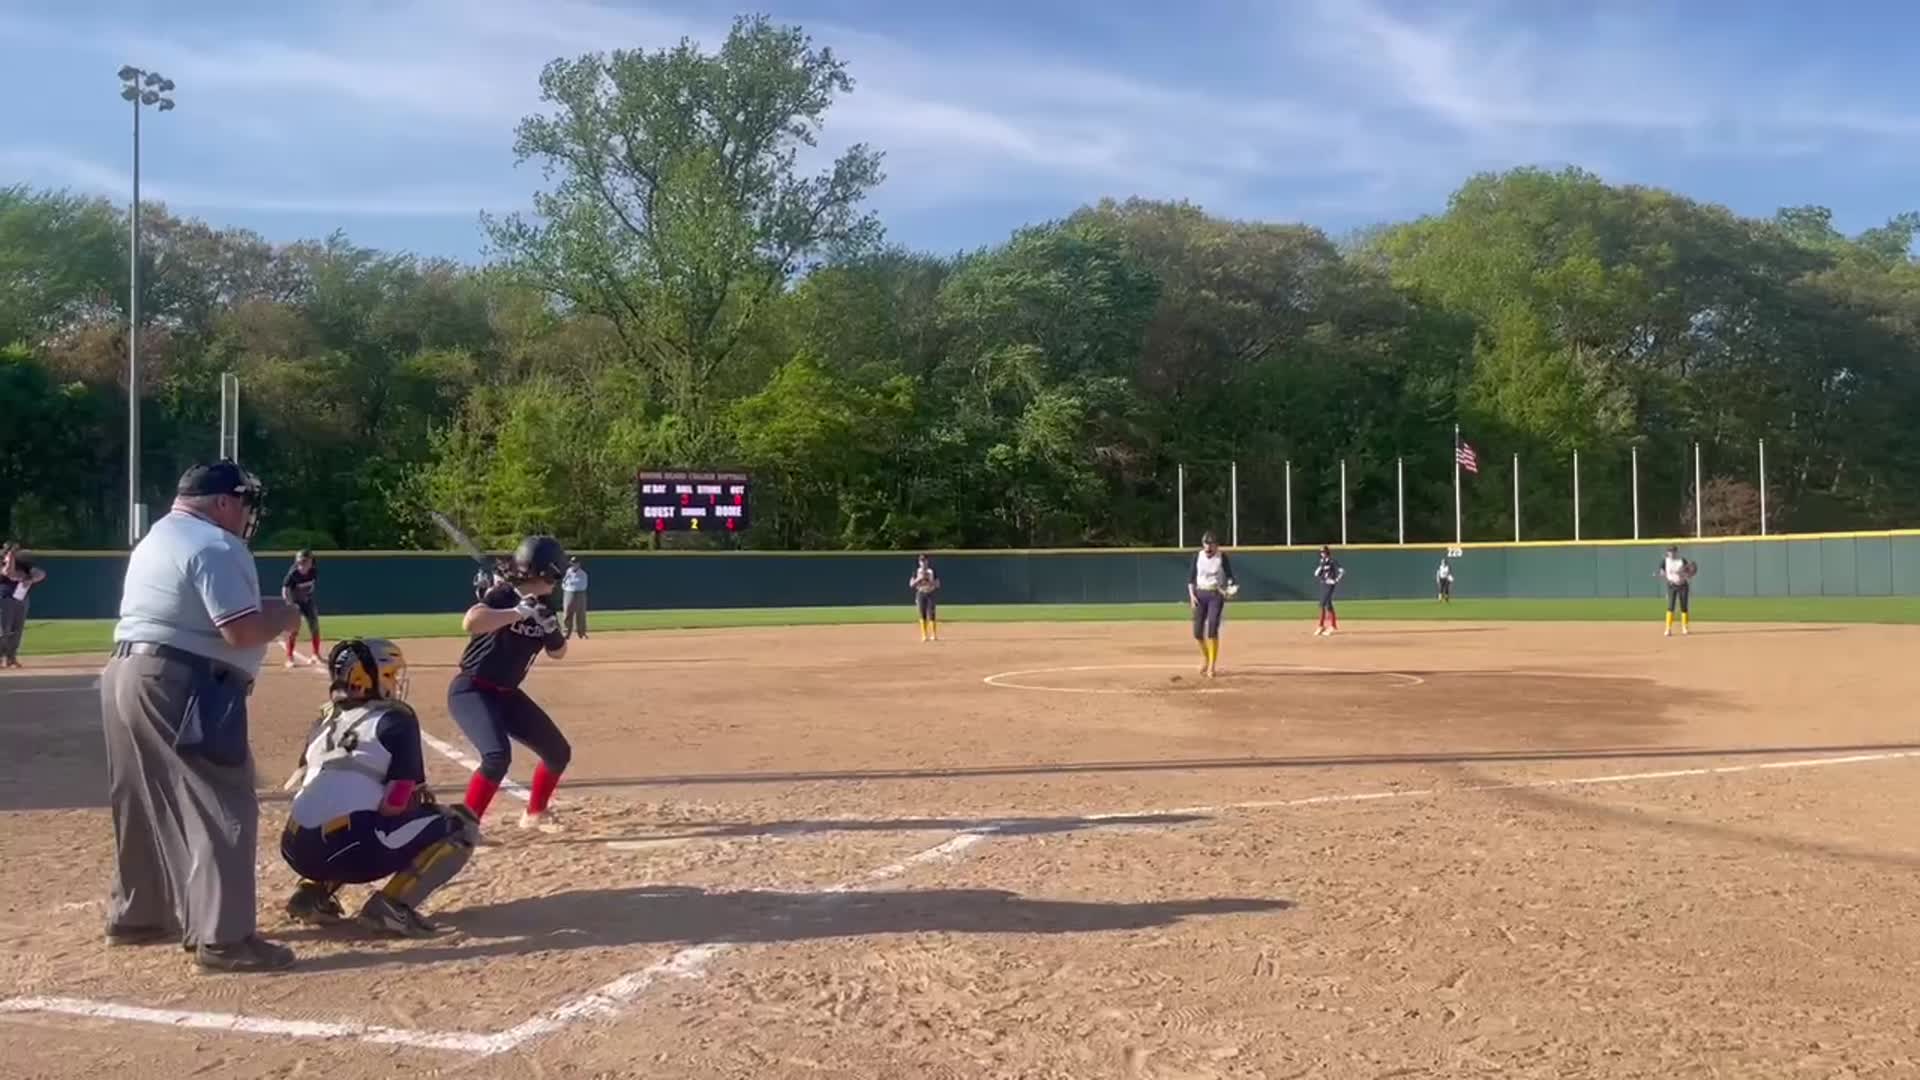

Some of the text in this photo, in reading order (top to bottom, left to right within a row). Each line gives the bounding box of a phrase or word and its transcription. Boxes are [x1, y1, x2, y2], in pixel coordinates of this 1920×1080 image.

[644, 507, 675, 517] GUEST
[715, 506, 742, 516] HOME
[690, 518, 698, 529] 2
